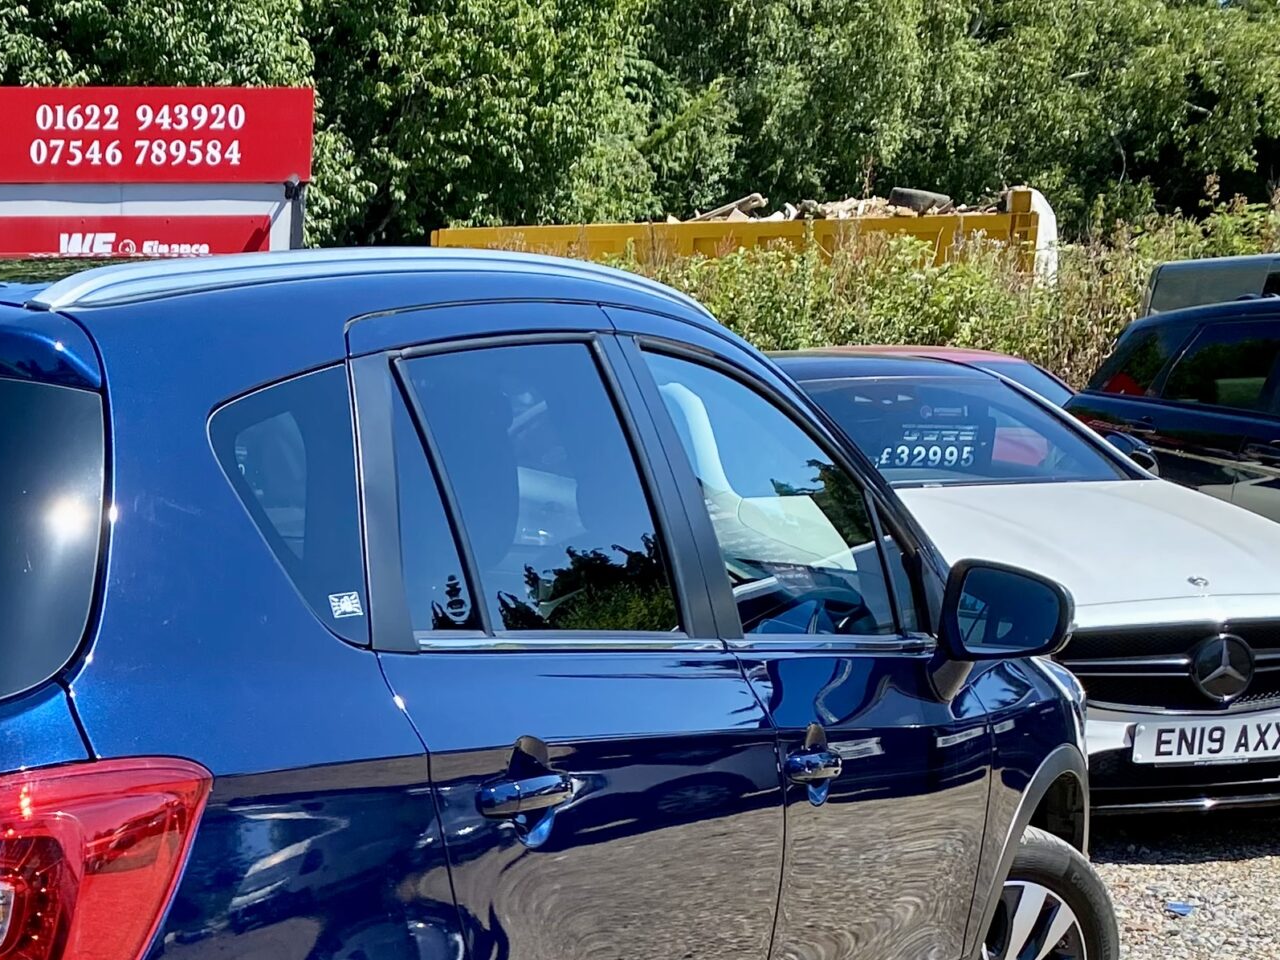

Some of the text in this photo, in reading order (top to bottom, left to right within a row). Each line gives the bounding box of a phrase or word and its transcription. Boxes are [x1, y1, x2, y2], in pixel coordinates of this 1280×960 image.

[35, 104, 246, 131] 01622 943920
[29, 138, 242, 166] 07546 789584
[142, 240, 210, 254] Finance
[880, 445, 974, 467] £32995
[1155, 726, 1226, 756] EN19
